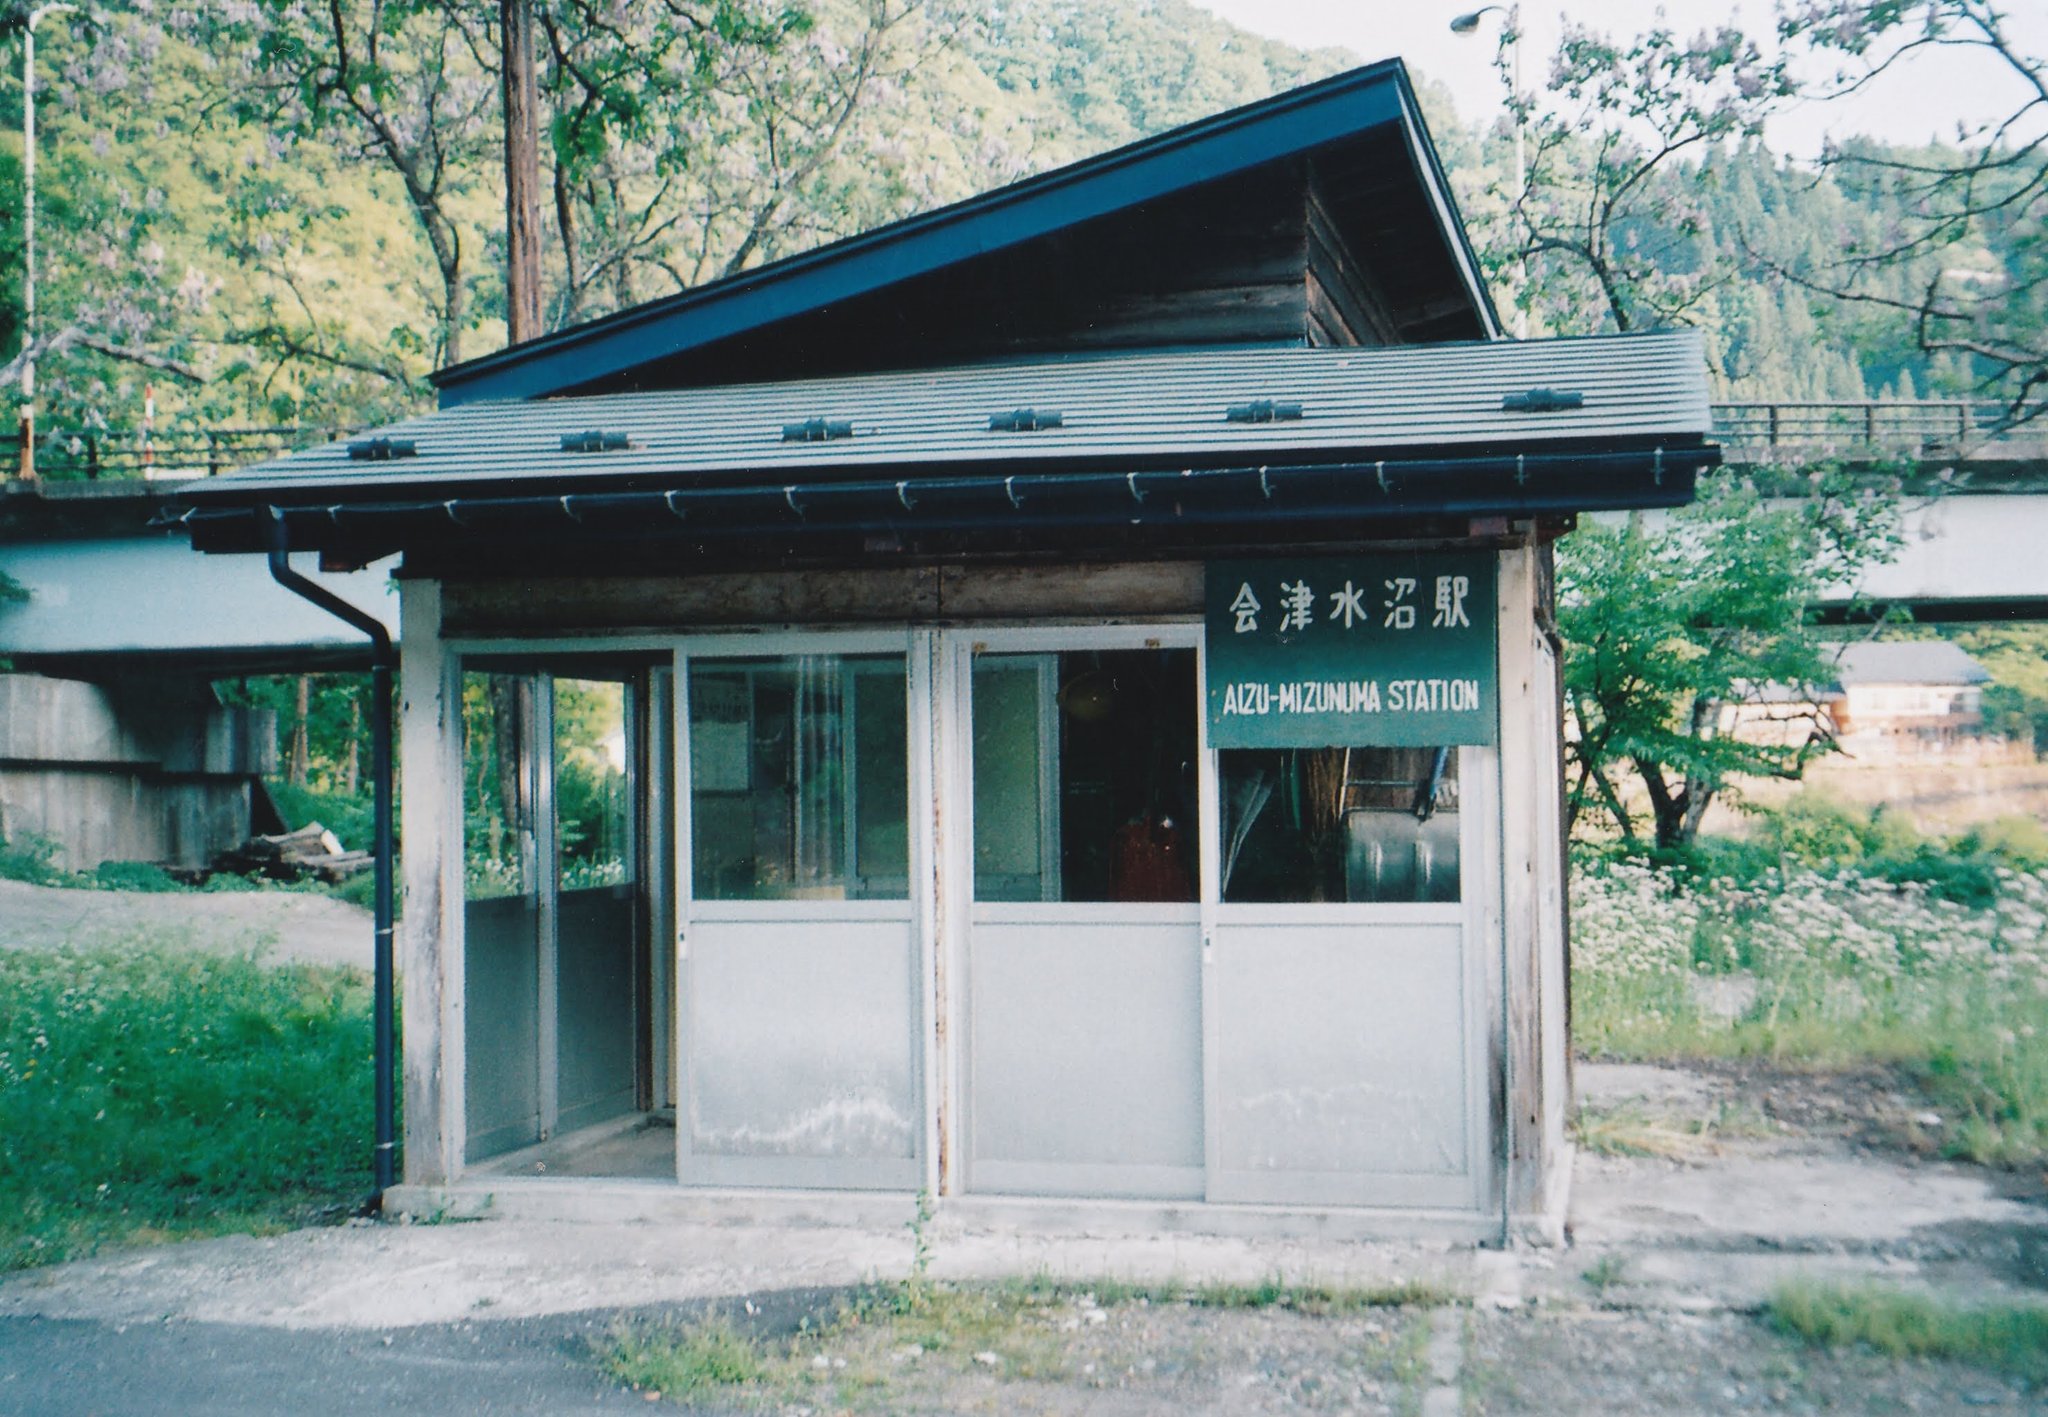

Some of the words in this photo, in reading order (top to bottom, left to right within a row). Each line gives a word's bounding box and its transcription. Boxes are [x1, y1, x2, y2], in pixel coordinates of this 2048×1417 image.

[1230, 575, 1470, 633] 会津水沼駅
[1223, 681, 1381, 715] AIZU-MIZUNUMA
[1388, 679, 1479, 711] STATION
